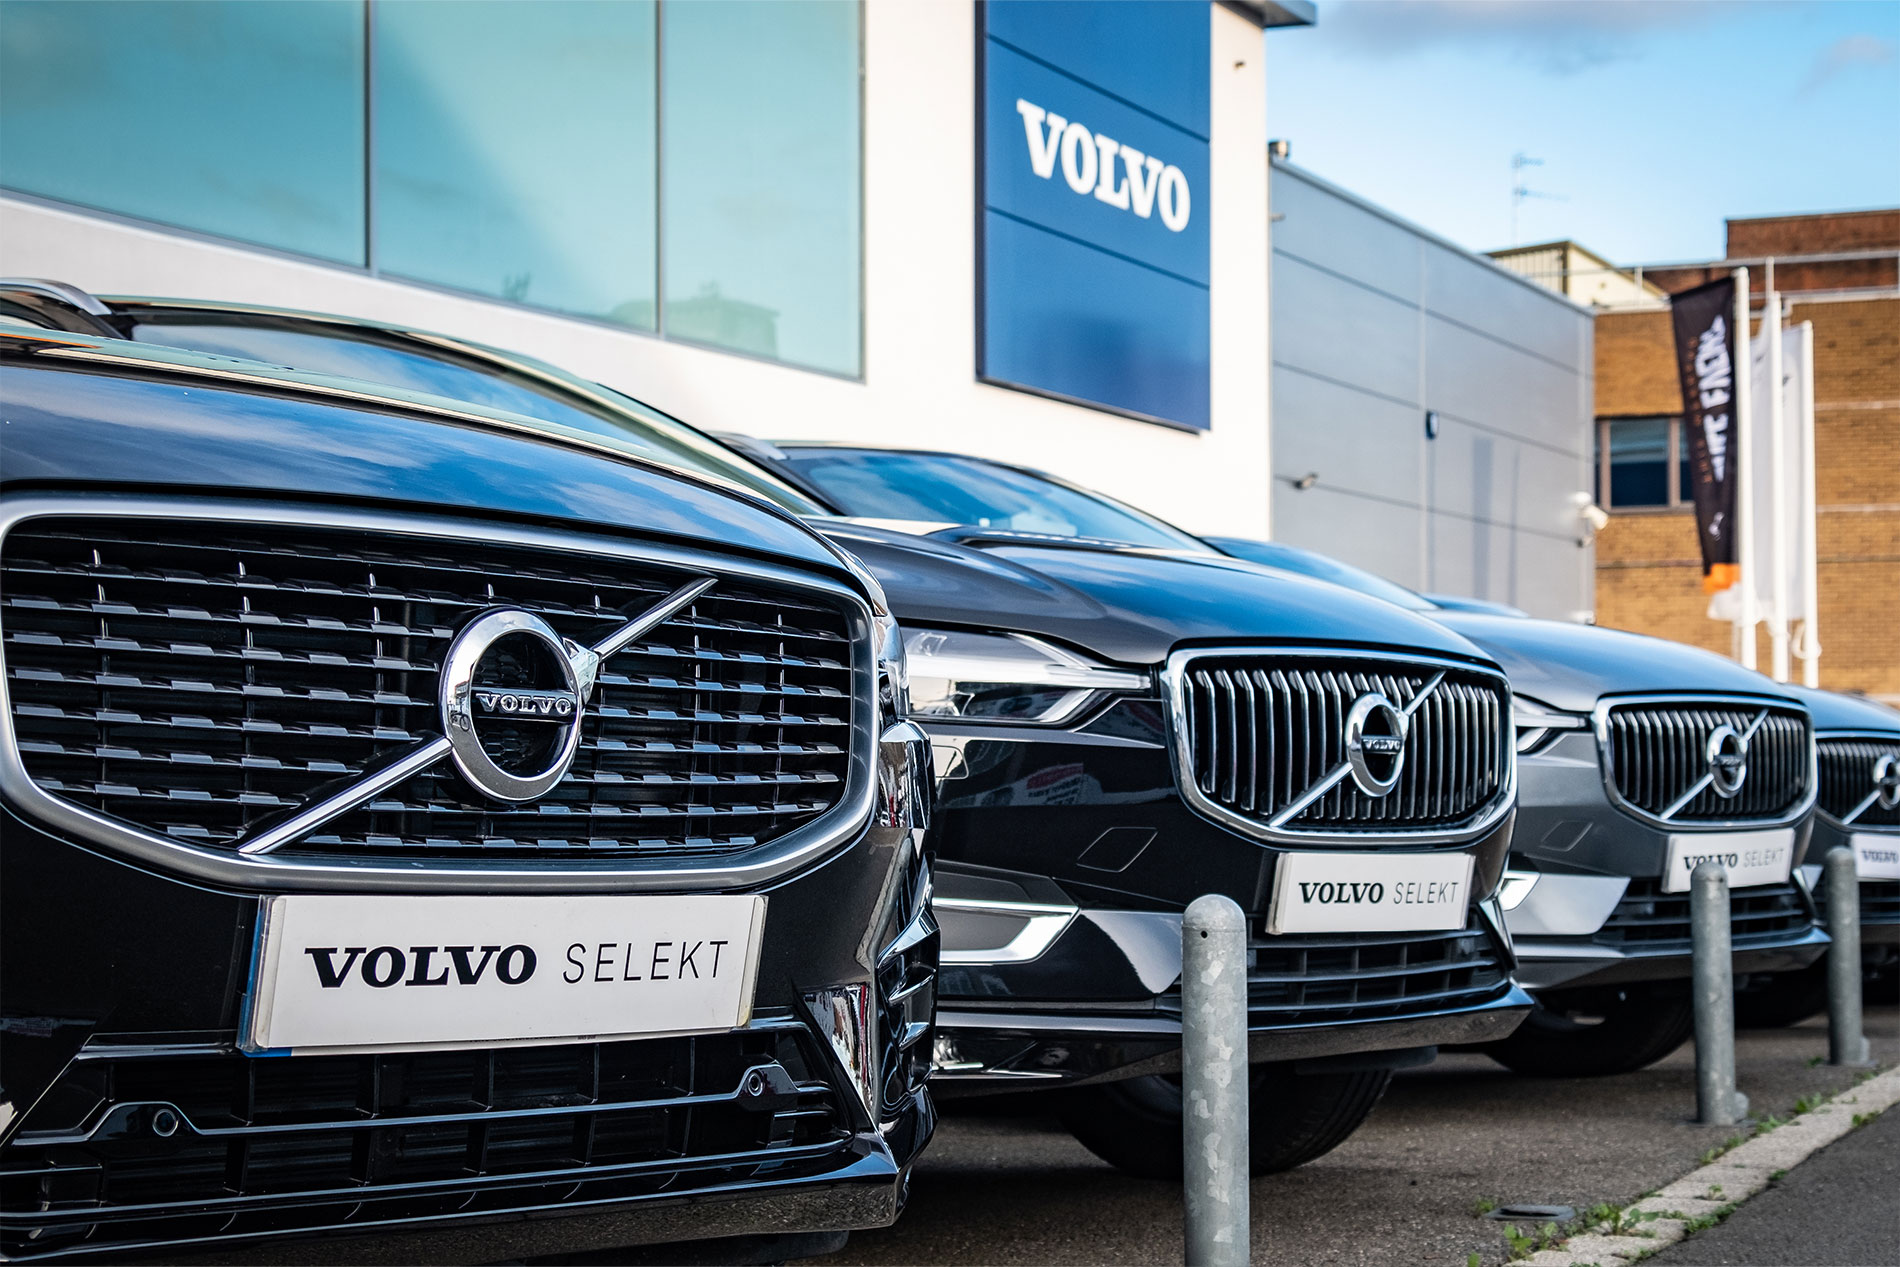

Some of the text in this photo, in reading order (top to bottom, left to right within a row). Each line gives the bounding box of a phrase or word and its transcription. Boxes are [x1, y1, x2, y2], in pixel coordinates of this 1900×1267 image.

[1017, 98, 1191, 233] VOLVO
[476, 692, 571, 716] VOLVO
[1743, 848, 1784, 868] SELEKT
[1299, 881, 1459, 905] VOLVO SELEKT
[304, 940, 729, 989] VOLVO SELEKT
